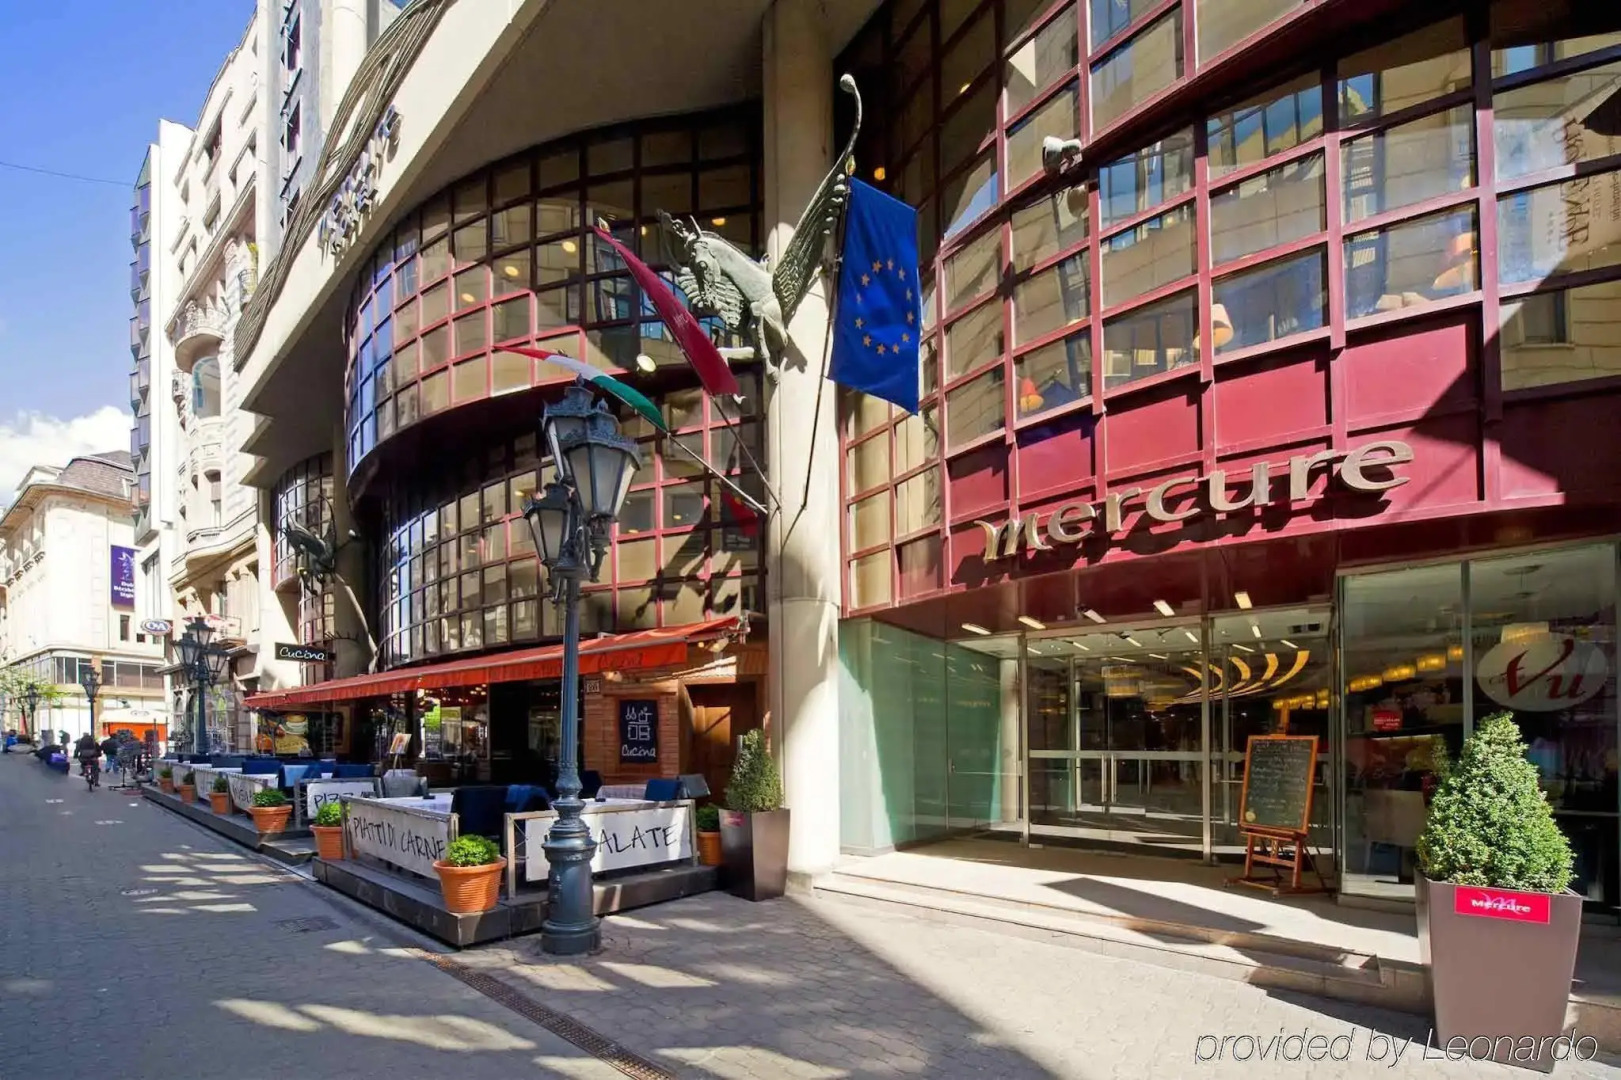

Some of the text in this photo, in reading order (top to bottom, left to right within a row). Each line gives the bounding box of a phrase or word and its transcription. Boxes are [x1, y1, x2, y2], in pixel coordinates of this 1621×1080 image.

[973, 440, 1414, 562] mercure
[279, 646, 325, 660] Cucina
[621, 744, 656, 757] Cucina
[598, 823, 678, 854] ALATE
[1471, 899, 1531, 912] Mercure
